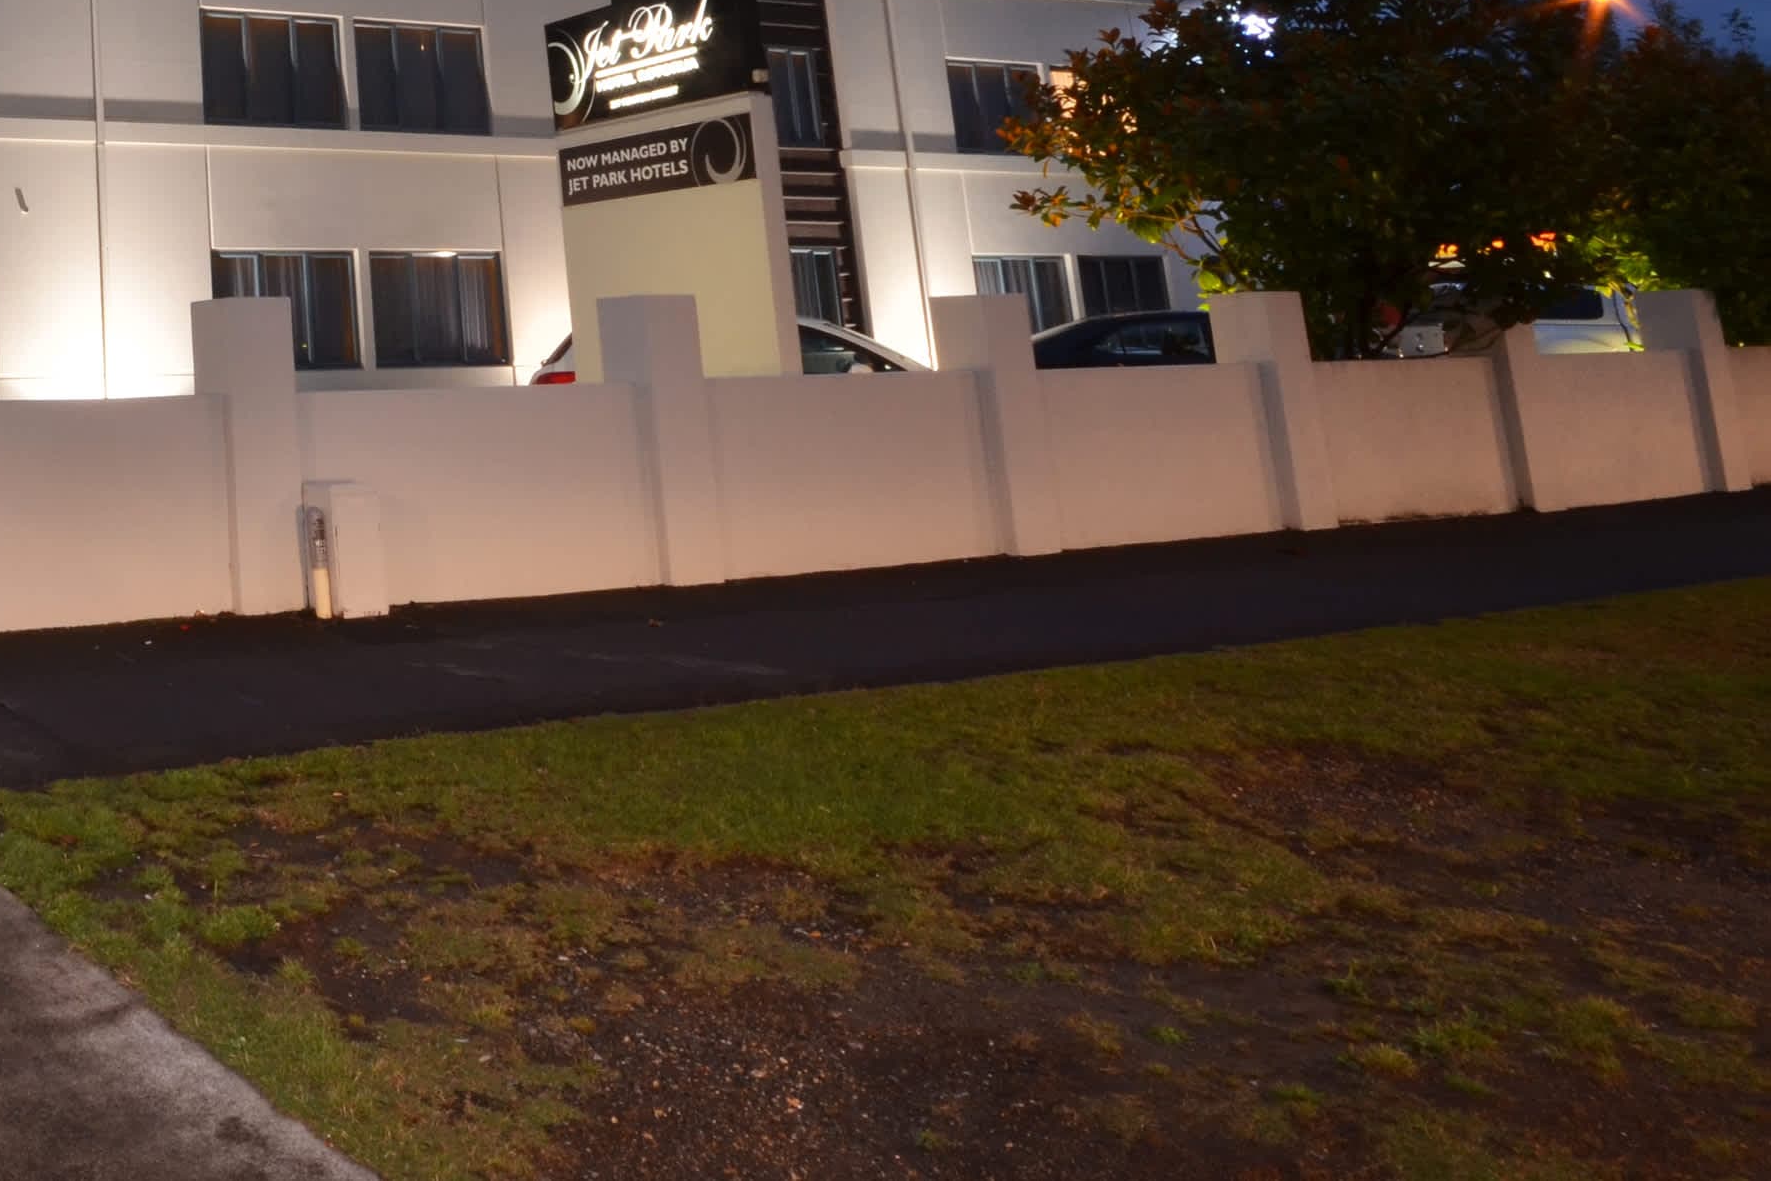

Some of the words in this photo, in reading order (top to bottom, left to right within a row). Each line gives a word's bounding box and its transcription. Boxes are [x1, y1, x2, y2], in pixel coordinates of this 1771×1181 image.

[569, 20, 627, 84] Jet
[566, 154, 598, 171] NOW
[601, 142, 667, 166] MANAGED
[670, 137, 688, 153] BY
[568, 176, 589, 196] JET
[592, 170, 628, 188] PARK
[630, 159, 689, 182] HOTELS
